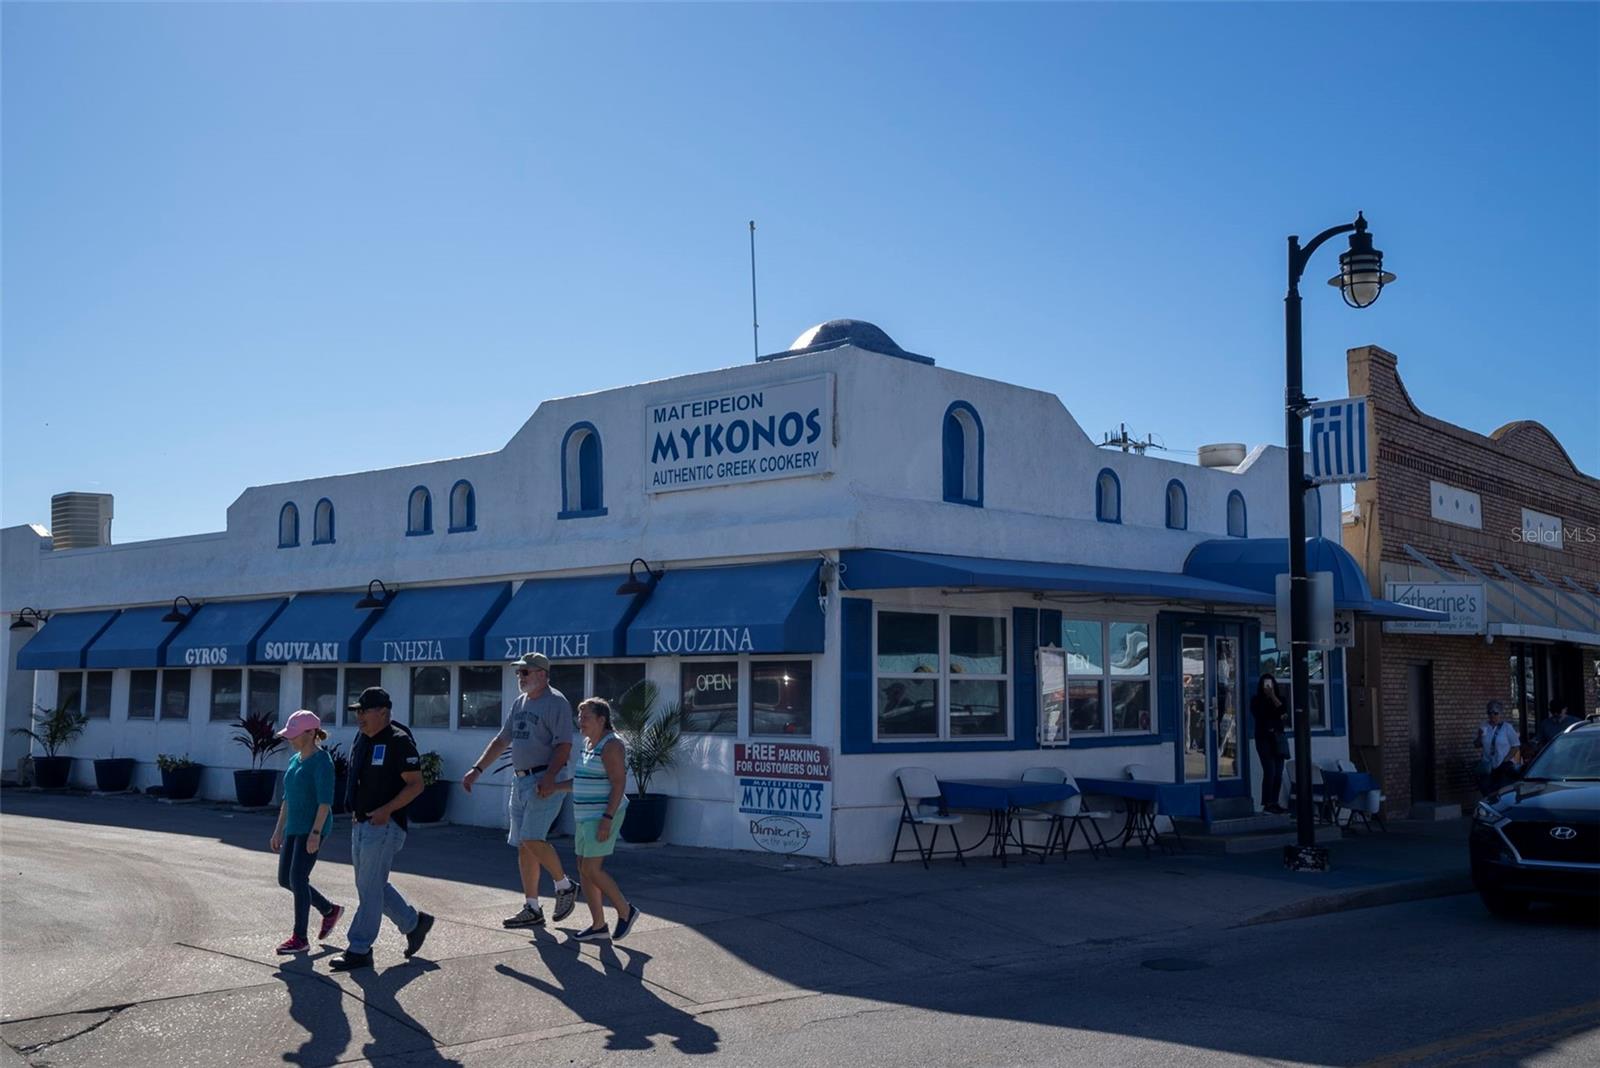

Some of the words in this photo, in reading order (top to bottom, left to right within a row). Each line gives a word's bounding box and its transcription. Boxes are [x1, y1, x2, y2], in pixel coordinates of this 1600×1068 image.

[654, 392, 763, 423] ΜΑΓΕΙΡΕΙΟΝ
[651, 408, 821, 464] MYKONOS
[653, 464, 713, 486] AUTHENTIC
[717, 459, 756, 478] GREEK
[760, 451, 819, 473] COOKERY
[383, 640, 445, 661] ΓΝΗΣΙΑ
[504, 634, 589, 659] ΣΠΙΤΙΚΗ
[652, 628, 754, 652] KOUZINA
[185, 648, 228, 665] GYROS
[265, 642, 339, 661] SOUVLAKI
[1067, 653, 1090, 670] PEN
[696, 673, 731, 692] OPEN
[744, 744, 776, 760] FREE
[779, 749, 820, 763] PARKING
[736, 760, 753, 772] FOR
[754, 761, 805, 775] CUSTOMERS
[806, 764, 829, 776] ONLY
[741, 786, 822, 812] MYKONOS
